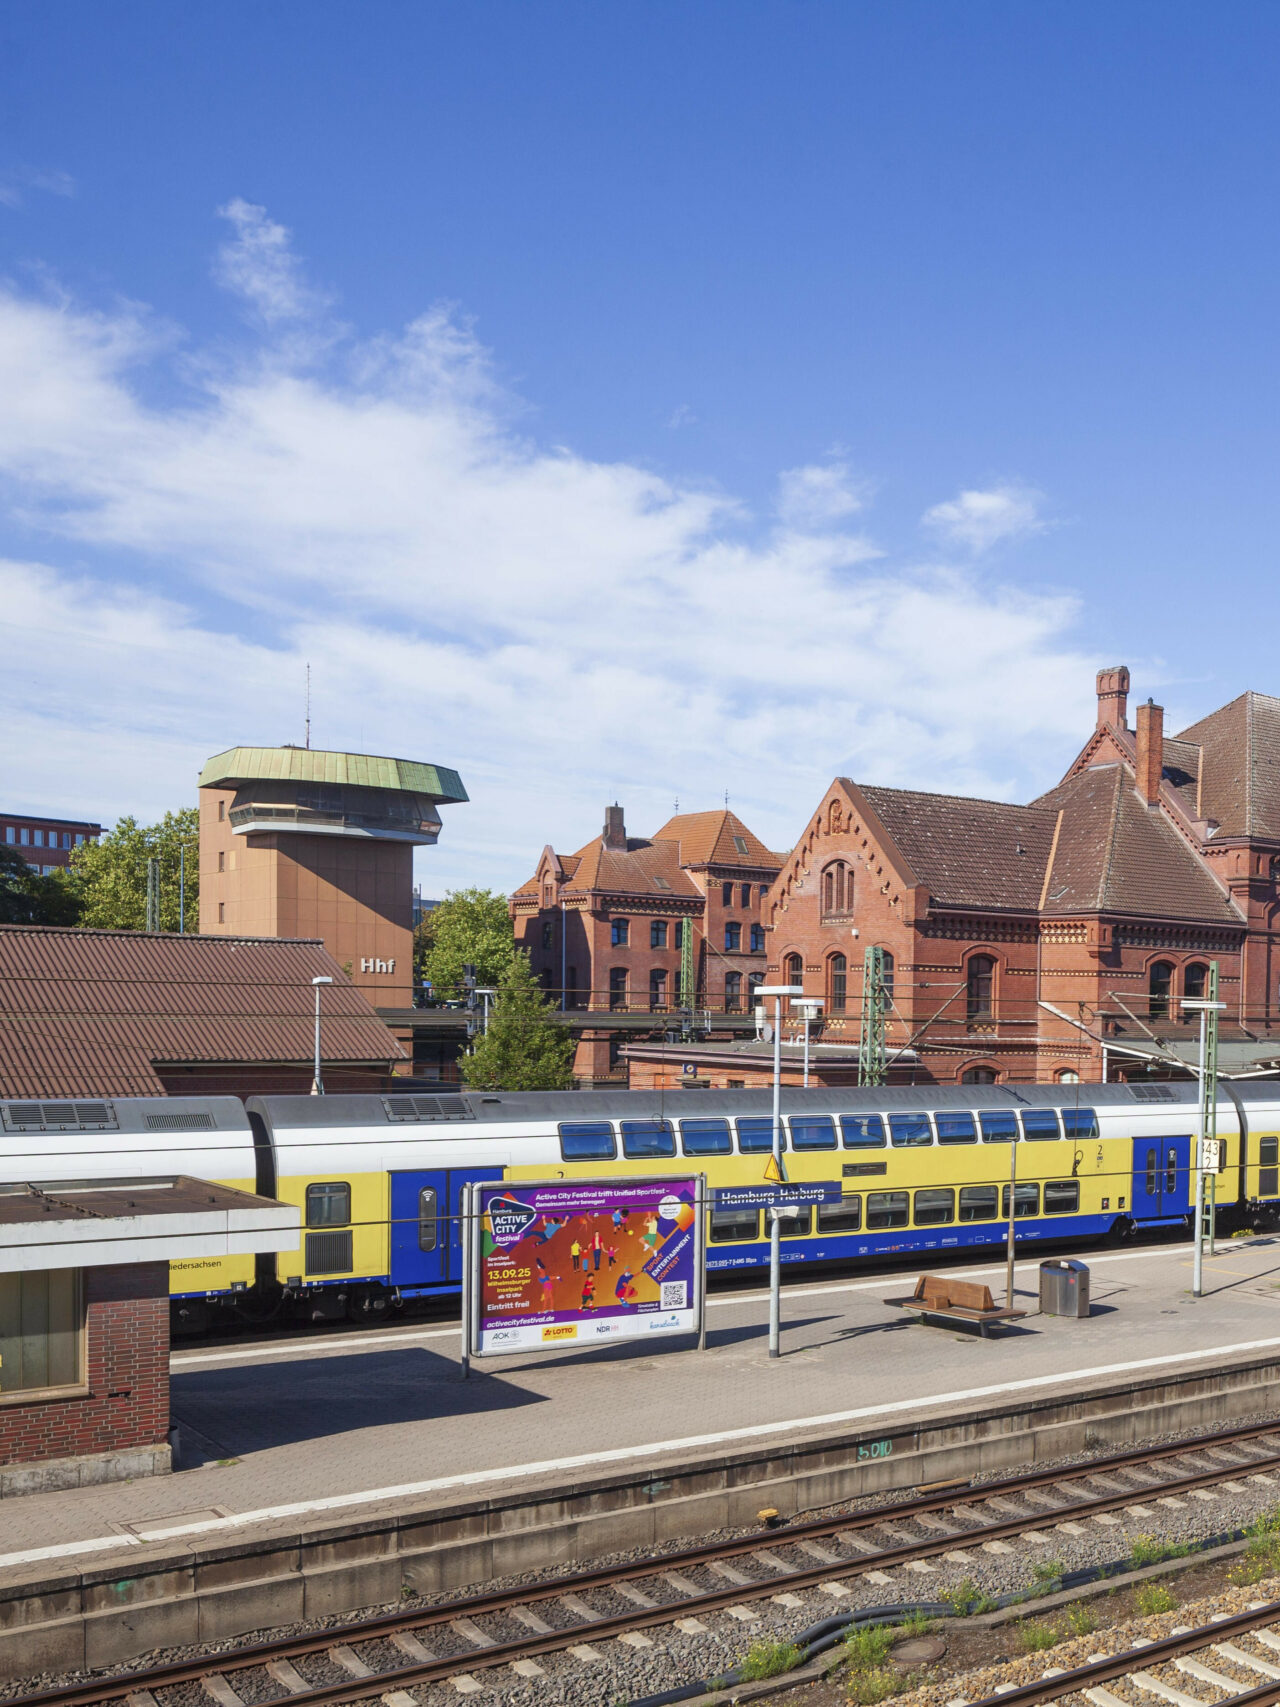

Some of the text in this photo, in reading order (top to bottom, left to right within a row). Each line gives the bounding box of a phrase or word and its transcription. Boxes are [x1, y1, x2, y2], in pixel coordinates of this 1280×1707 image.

[361, 958, 395, 973] Hhf
[1098, 1145, 1103, 1155] 2
[1205, 1157, 1211, 1169] 2
[535, 1187, 665, 1201] Active City Festival trifft Unified Sportfest
[495, 1214, 528, 1224] ACTIVE
[496, 1224, 517, 1233] CITY
[651, 1233, 691, 1277] ENTERTAINMENT
[169, 1260, 221, 1271] iedersachsen
[647, 1253, 664, 1271] SPORT
[487, 1268, 531, 1280] 13.09.25
[657, 1256, 680, 1281] CONTEST
[488, 1279, 531, 1287] Wilhelmsburger
[487, 1302, 514, 1311] Eintritt
[486, 1316, 555, 1328] activecityfestival.de
[552, 1327, 573, 1335] LOTTO
[596, 1325, 610, 1333] NDR
[492, 1332, 510, 1340] AOK
